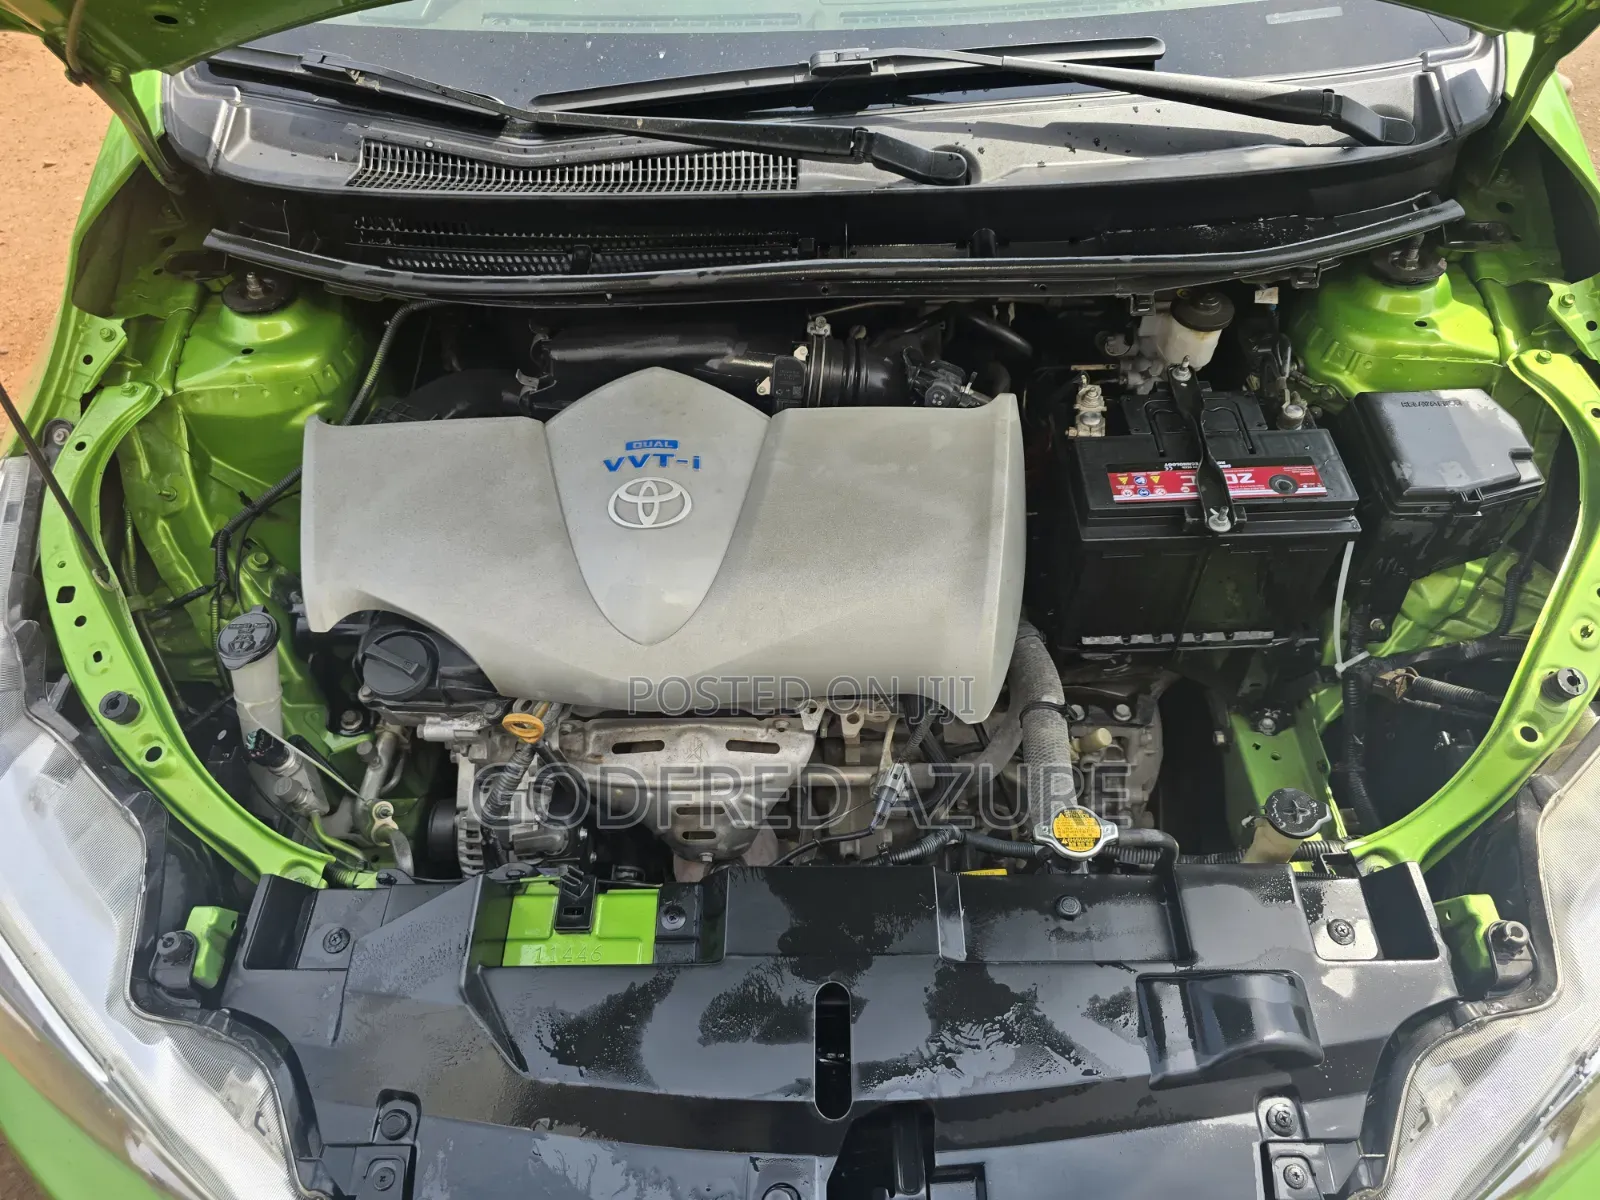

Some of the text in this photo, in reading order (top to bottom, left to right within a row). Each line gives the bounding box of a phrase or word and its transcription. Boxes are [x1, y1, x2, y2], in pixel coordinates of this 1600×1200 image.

[632, 440, 674, 449] DUAL
[603, 453, 701, 472] VVT-i
[533, 944, 602, 964] 11446
